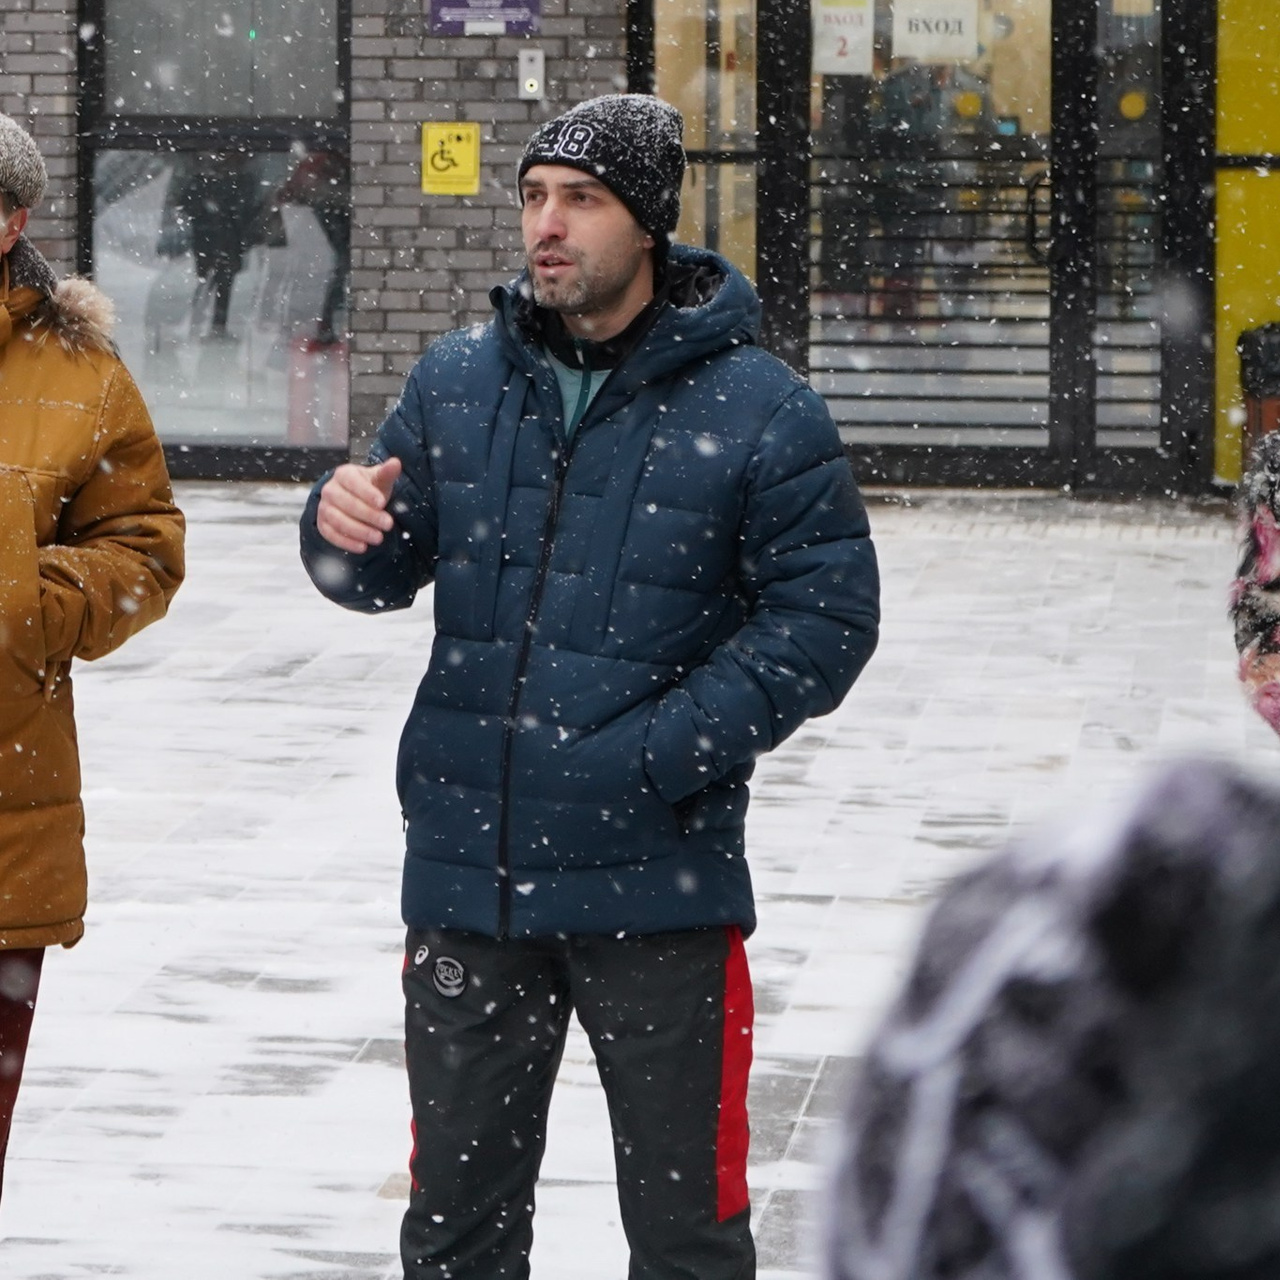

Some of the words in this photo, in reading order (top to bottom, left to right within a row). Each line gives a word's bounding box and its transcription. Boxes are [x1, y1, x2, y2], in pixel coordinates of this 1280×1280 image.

[823, 13, 864, 27] ВХОД
[907, 17, 964, 37] ВХОД
[836, 35, 849, 58] 2
[537, 121, 595, 160] 48
